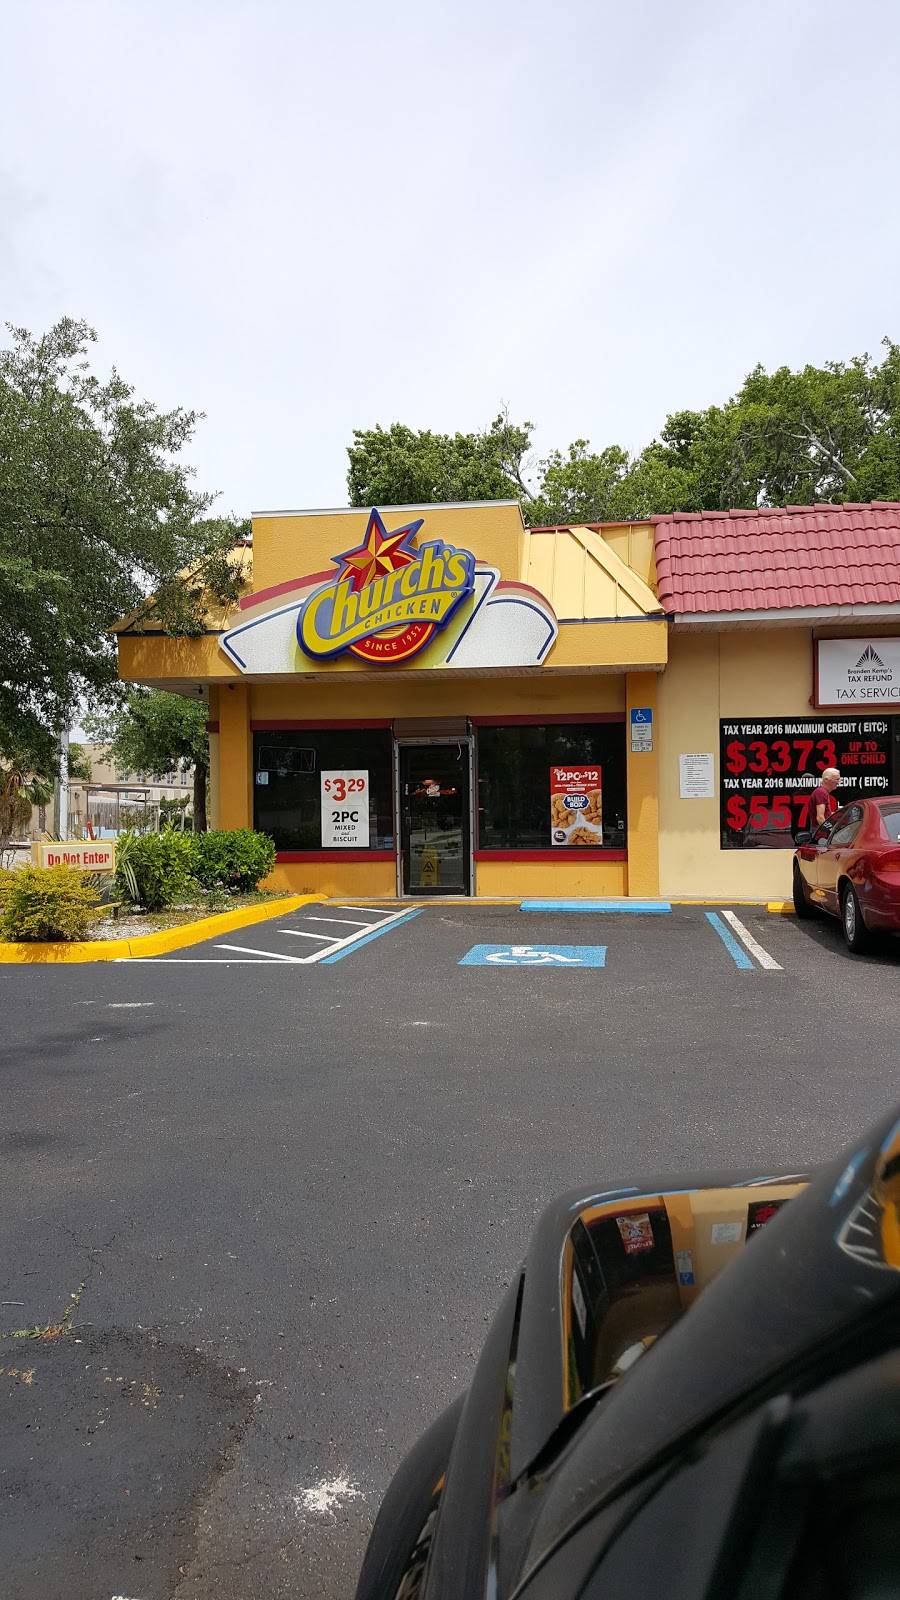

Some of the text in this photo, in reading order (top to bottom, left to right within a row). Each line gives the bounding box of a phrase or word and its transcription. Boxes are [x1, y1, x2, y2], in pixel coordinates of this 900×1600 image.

[302, 547, 467, 654] Church's
[364, 598, 442, 630] CHICKEN
[364, 625, 423, 651] SINCE 1952
[864, 674, 892, 682] REFUND
[836, 687, 900, 699] TAX SERVIC
[723, 724, 739, 735] TAX
[740, 724, 762, 734] YEAR
[764, 724, 783, 734] 2016
[784, 724, 824, 734] MAXIMUM
[826, 722, 856, 734] CREDIT
[849, 741, 878, 752] UP TO
[726, 740, 838, 776] $3,373
[841, 754, 886, 764] ONE CHILD
[556, 772, 580, 781] 12PC
[724, 778, 740, 789] TAX
[741, 778, 763, 788] YEAR
[764, 778, 784, 788] 2016
[332, 811, 358, 822] 2PC
[48, 852, 110, 866] Do Not Enter
